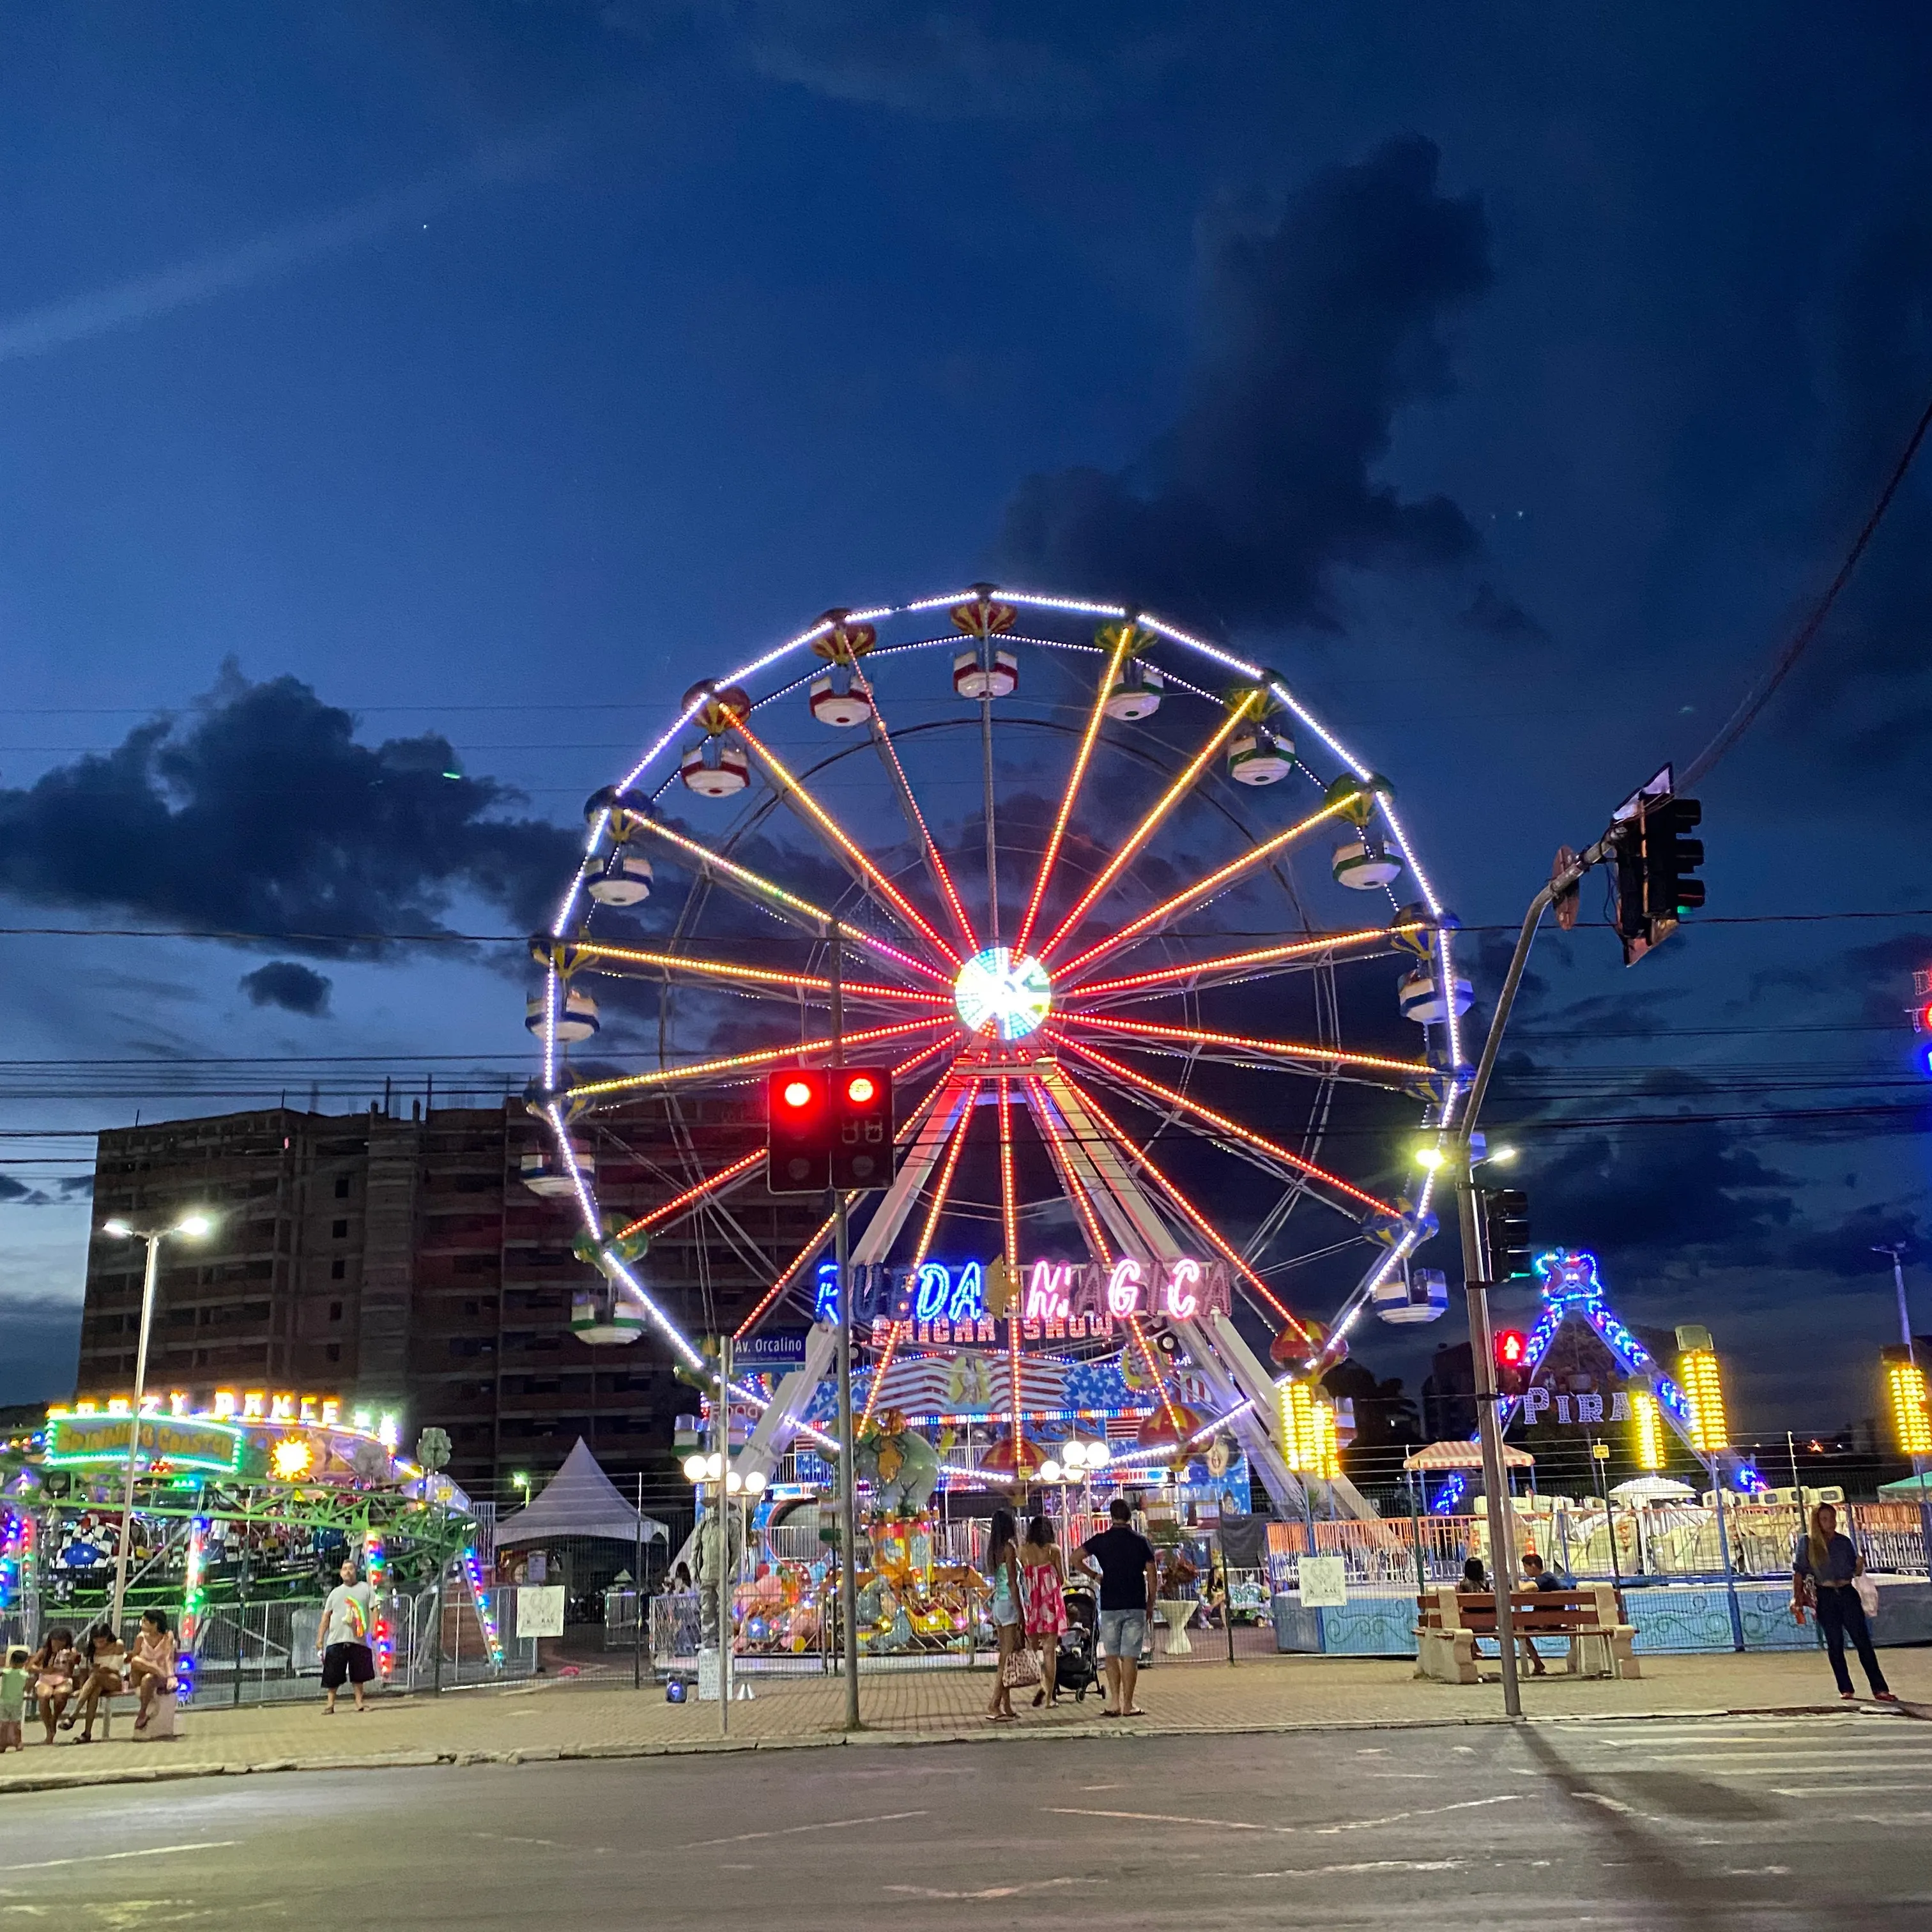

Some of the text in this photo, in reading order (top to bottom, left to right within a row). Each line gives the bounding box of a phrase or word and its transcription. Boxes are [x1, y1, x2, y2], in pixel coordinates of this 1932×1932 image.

[1026, 1257, 1231, 1319] MAGICA
[1023, 1311, 1113, 1340] SHOW
[735, 1336, 802, 1353] Av. Orcalino
[215, 1386, 341, 1423] DANCE
